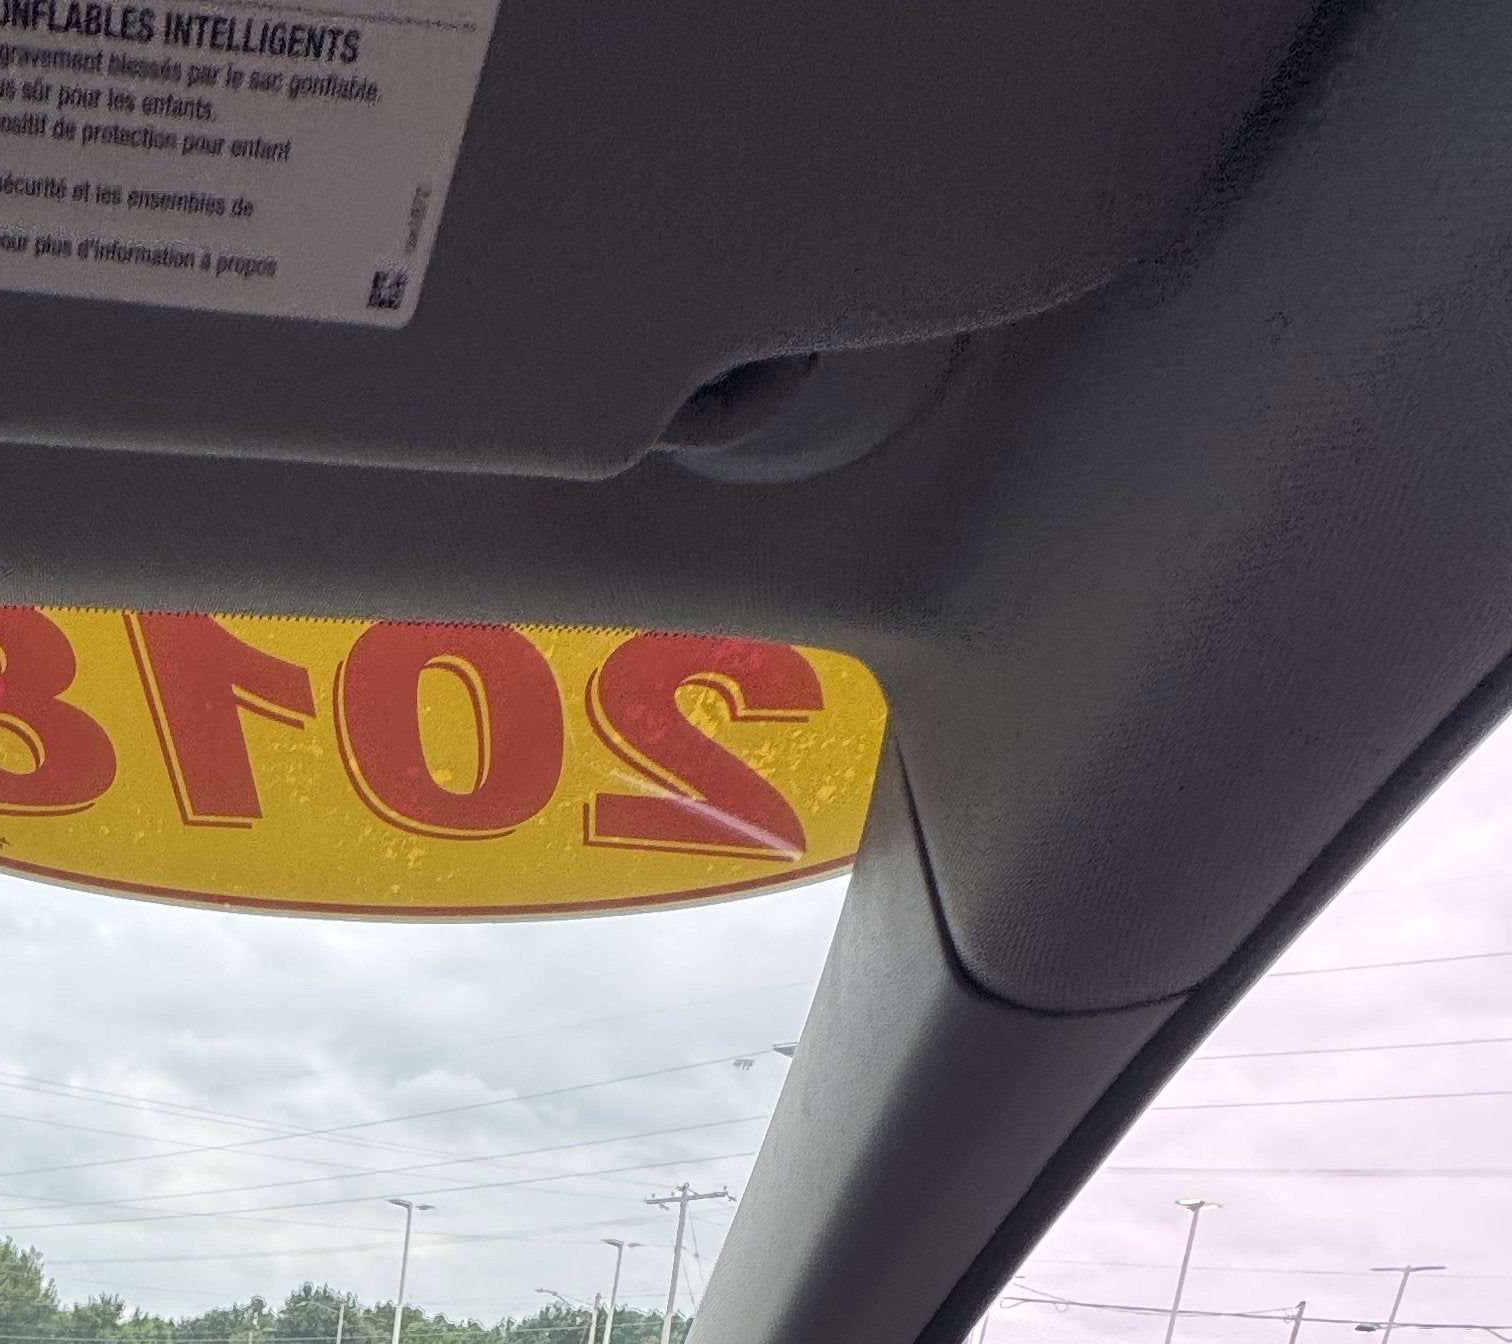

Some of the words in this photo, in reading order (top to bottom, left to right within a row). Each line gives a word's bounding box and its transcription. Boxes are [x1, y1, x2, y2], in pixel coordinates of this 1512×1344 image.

[164, 10, 361, 64] INTELLIGENTS
[59, 83, 102, 110] pour
[109, 87, 137, 112] les
[142, 94, 216, 122] enfants.
[187, 62, 221, 88] par
[225, 62, 245, 89] le
[249, 70, 284, 92] sac
[289, 73, 383, 106] gonflable.
[52, 116, 77, 140] de
[82, 119, 178, 150] protection
[182, 132, 225, 156] pour
[231, 136, 292, 163] enfant
[72, 181, 92, 203] et
[96, 184, 123, 205] les
[127, 190, 226, 216] ensembles
[231, 196, 255, 218] de
[34, 234, 73, 257] plus
[77, 236, 195, 268] d'information
[216, 254, 280, 279] propos
